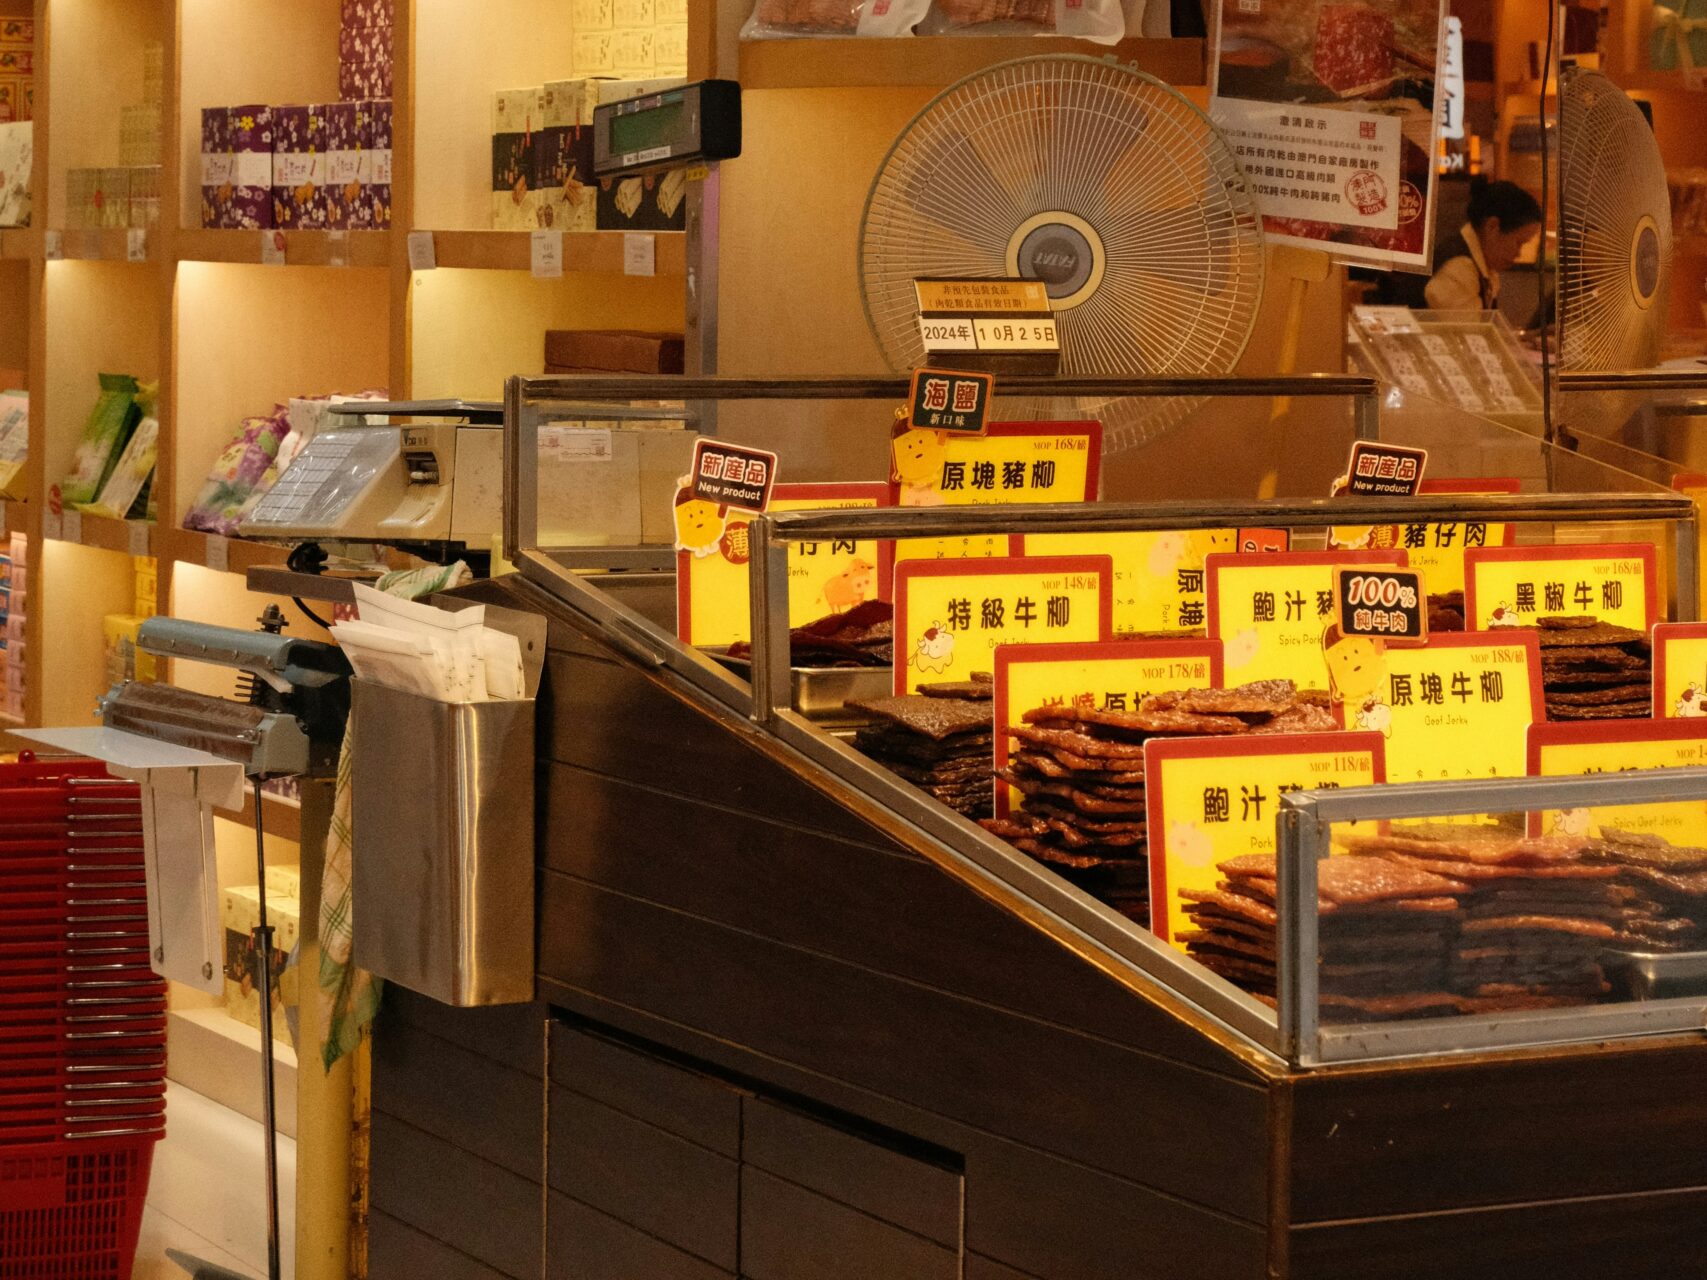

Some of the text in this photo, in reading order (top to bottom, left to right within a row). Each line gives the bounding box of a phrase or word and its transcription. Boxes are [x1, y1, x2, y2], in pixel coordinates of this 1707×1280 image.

[923, 326, 971, 341] 2024年
[924, 378, 979, 412] 海鹽
[929, 412, 965, 426] 新口味
[698, 481, 761, 502] New product
[1353, 480, 1410, 495] New product
[1404, 522, 1487, 549] 豬仔肉
[1042, 579, 1061, 590] MOP
[1349, 576, 1417, 608] 100%
[1515, 580, 1623, 613] 黑椒牛柳
[947, 596, 1070, 631] 特級牛柳
[1354, 609, 1407, 632] 純牛肉
[1279, 633, 1322, 647] Spicy Pork
[1142, 663, 1205, 679] MOP 178/磅
[1390, 670, 1504, 706] 原塊牛柳
[1251, 835, 1273, 849] Pork
